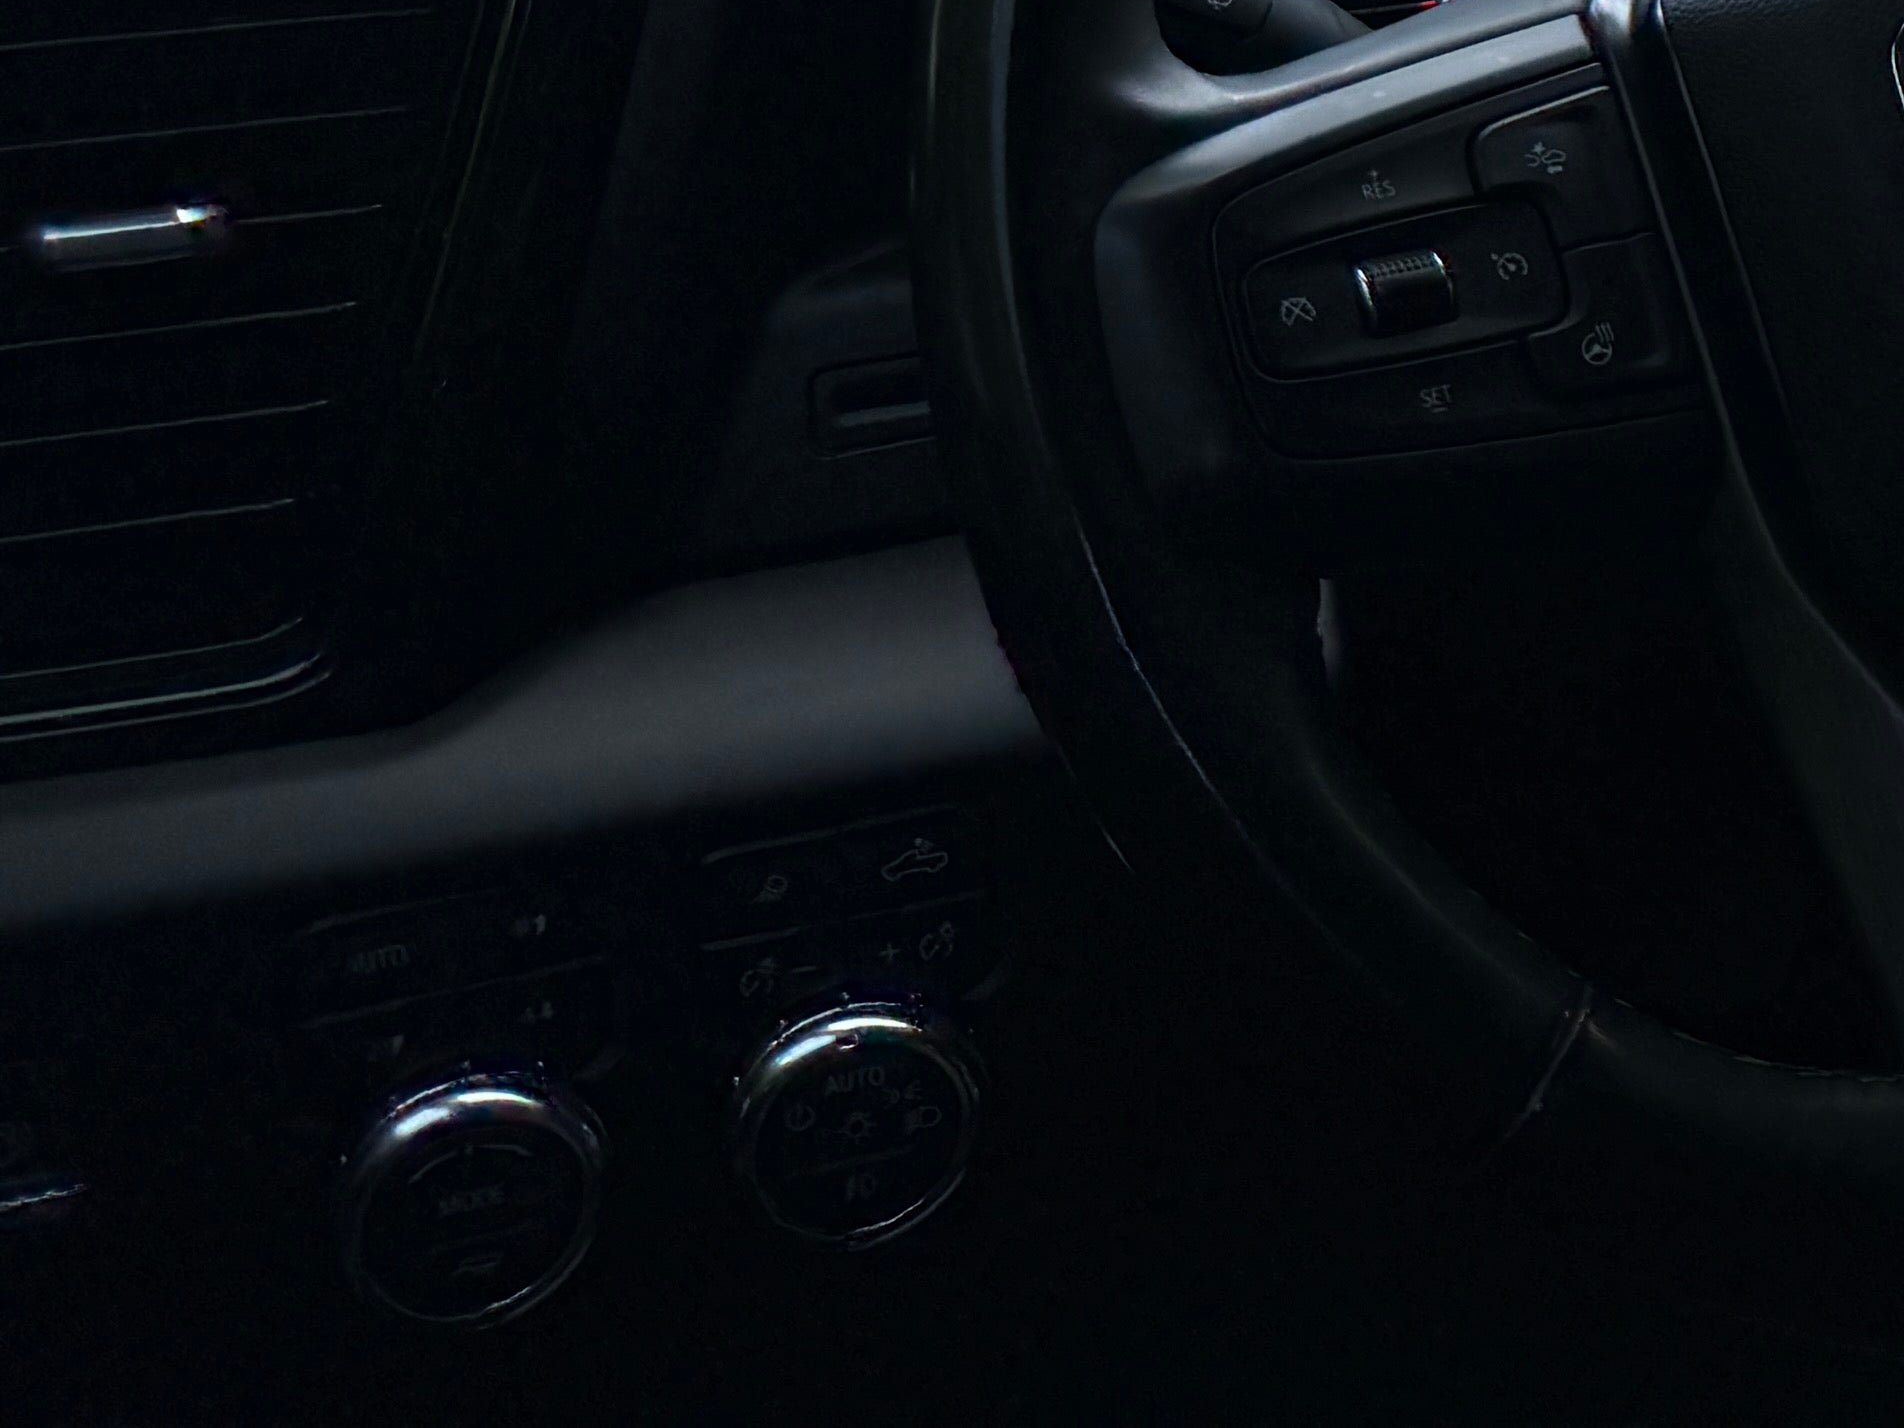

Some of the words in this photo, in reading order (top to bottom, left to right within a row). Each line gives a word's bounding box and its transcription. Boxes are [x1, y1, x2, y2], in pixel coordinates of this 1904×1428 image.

[1361, 179, 1397, 202] RES
[1420, 386, 1453, 410] SET
[824, 1066, 886, 1097] AUTO
